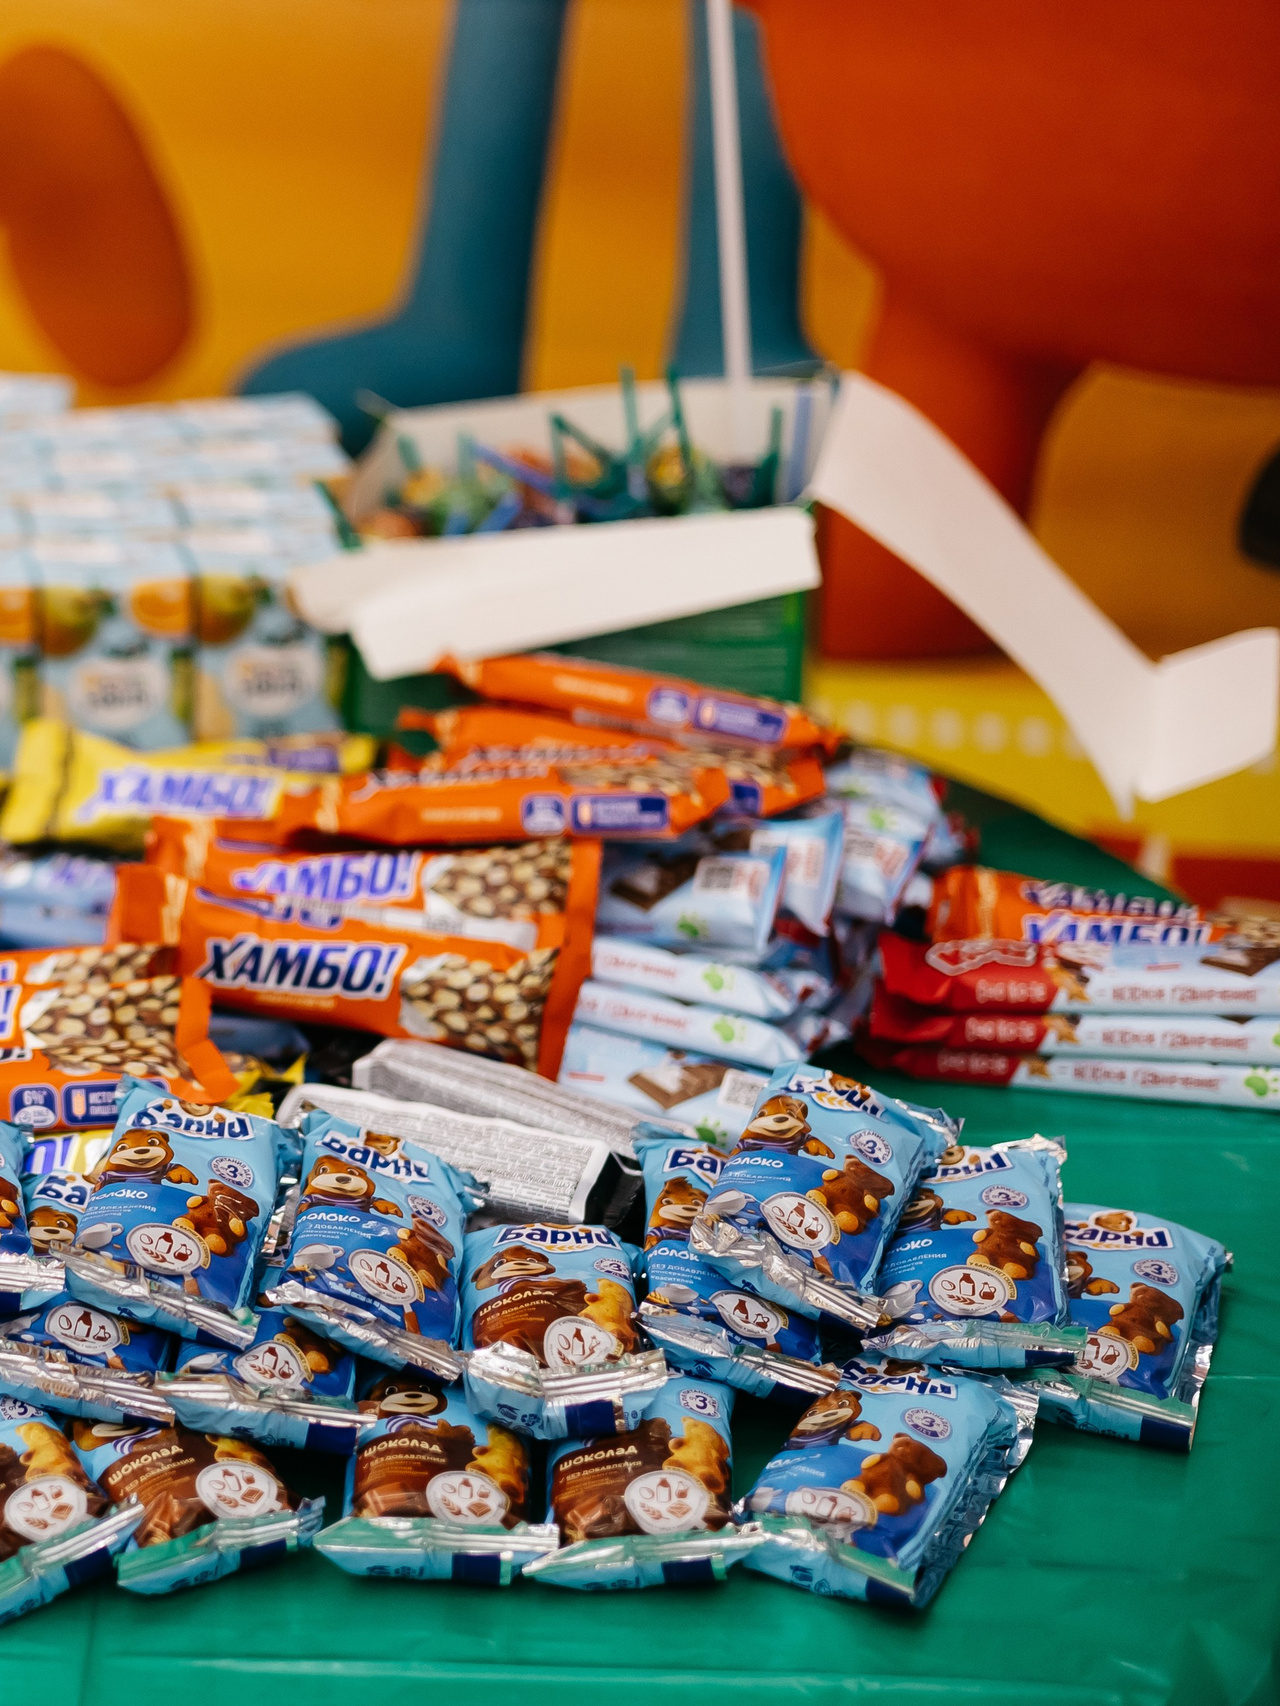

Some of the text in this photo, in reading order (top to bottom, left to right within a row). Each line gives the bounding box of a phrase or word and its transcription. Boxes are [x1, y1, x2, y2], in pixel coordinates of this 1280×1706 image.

[200, 939, 403, 994] ХАМБО!
[89, 1092, 117, 1104] ИСТО
[90, 1105, 118, 1115] ПИЩЕВ
[941, 1153, 1007, 1177] рни
[499, 1226, 617, 1249] Барни
[647, 1247, 700, 1262] МОЛОК
[843, 1361, 952, 1398] Барни
[363, 1437, 442, 1456] ШОКОЛАД
[560, 1445, 638, 1471] ШОКОЛАД
[109, 1444, 184, 1485] ШОКОЛАД
